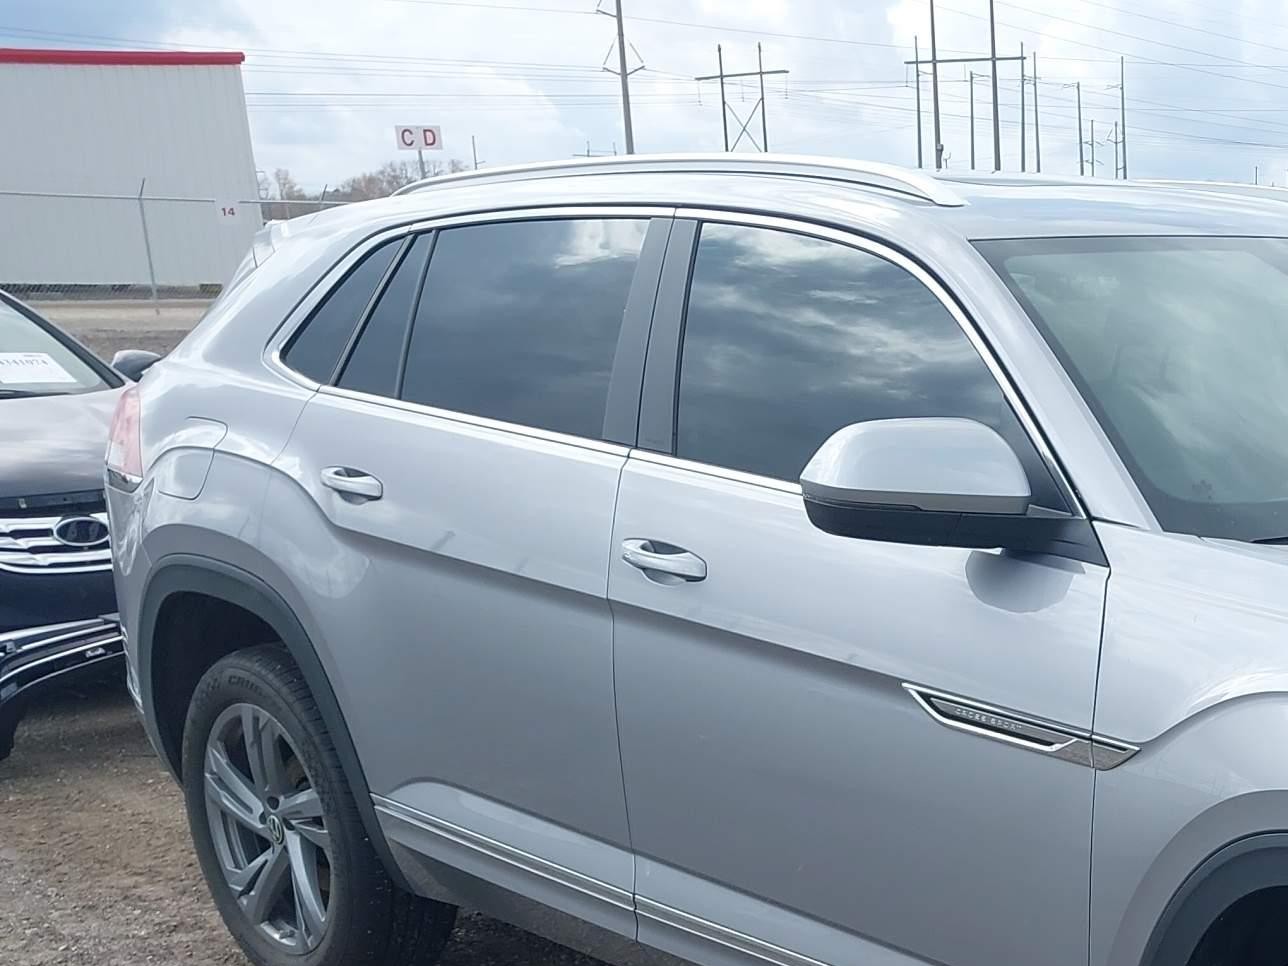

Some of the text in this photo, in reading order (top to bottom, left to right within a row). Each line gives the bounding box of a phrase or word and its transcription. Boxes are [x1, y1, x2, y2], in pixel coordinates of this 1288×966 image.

[401, 128, 436, 147] C D
[221, 207, 235, 216] 14
